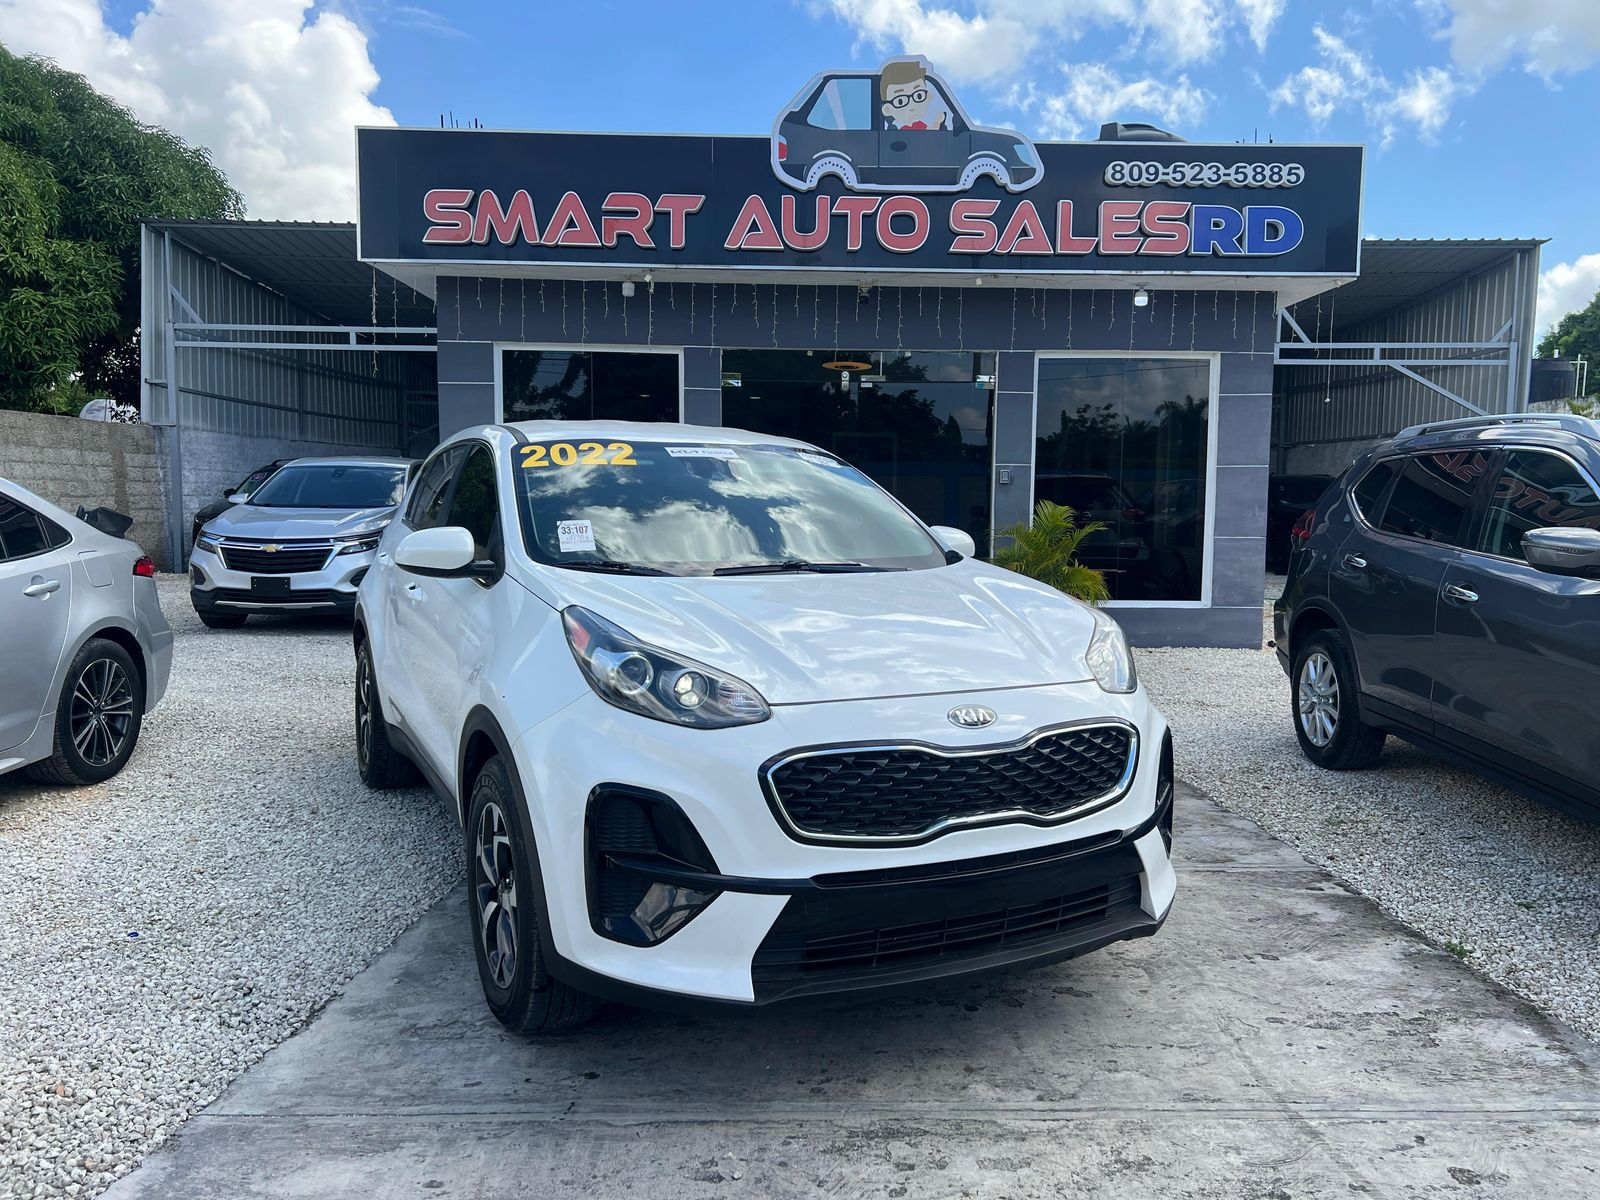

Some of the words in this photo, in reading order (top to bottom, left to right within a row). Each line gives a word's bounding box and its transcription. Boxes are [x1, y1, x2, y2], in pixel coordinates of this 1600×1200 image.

[1108, 162, 1303, 187] 809-523-5885
[422, 189, 706, 249] SMART
[723, 194, 930, 253] AUTO
[519, 442, 637, 468] 2022
[952, 707, 993, 725] KIA
